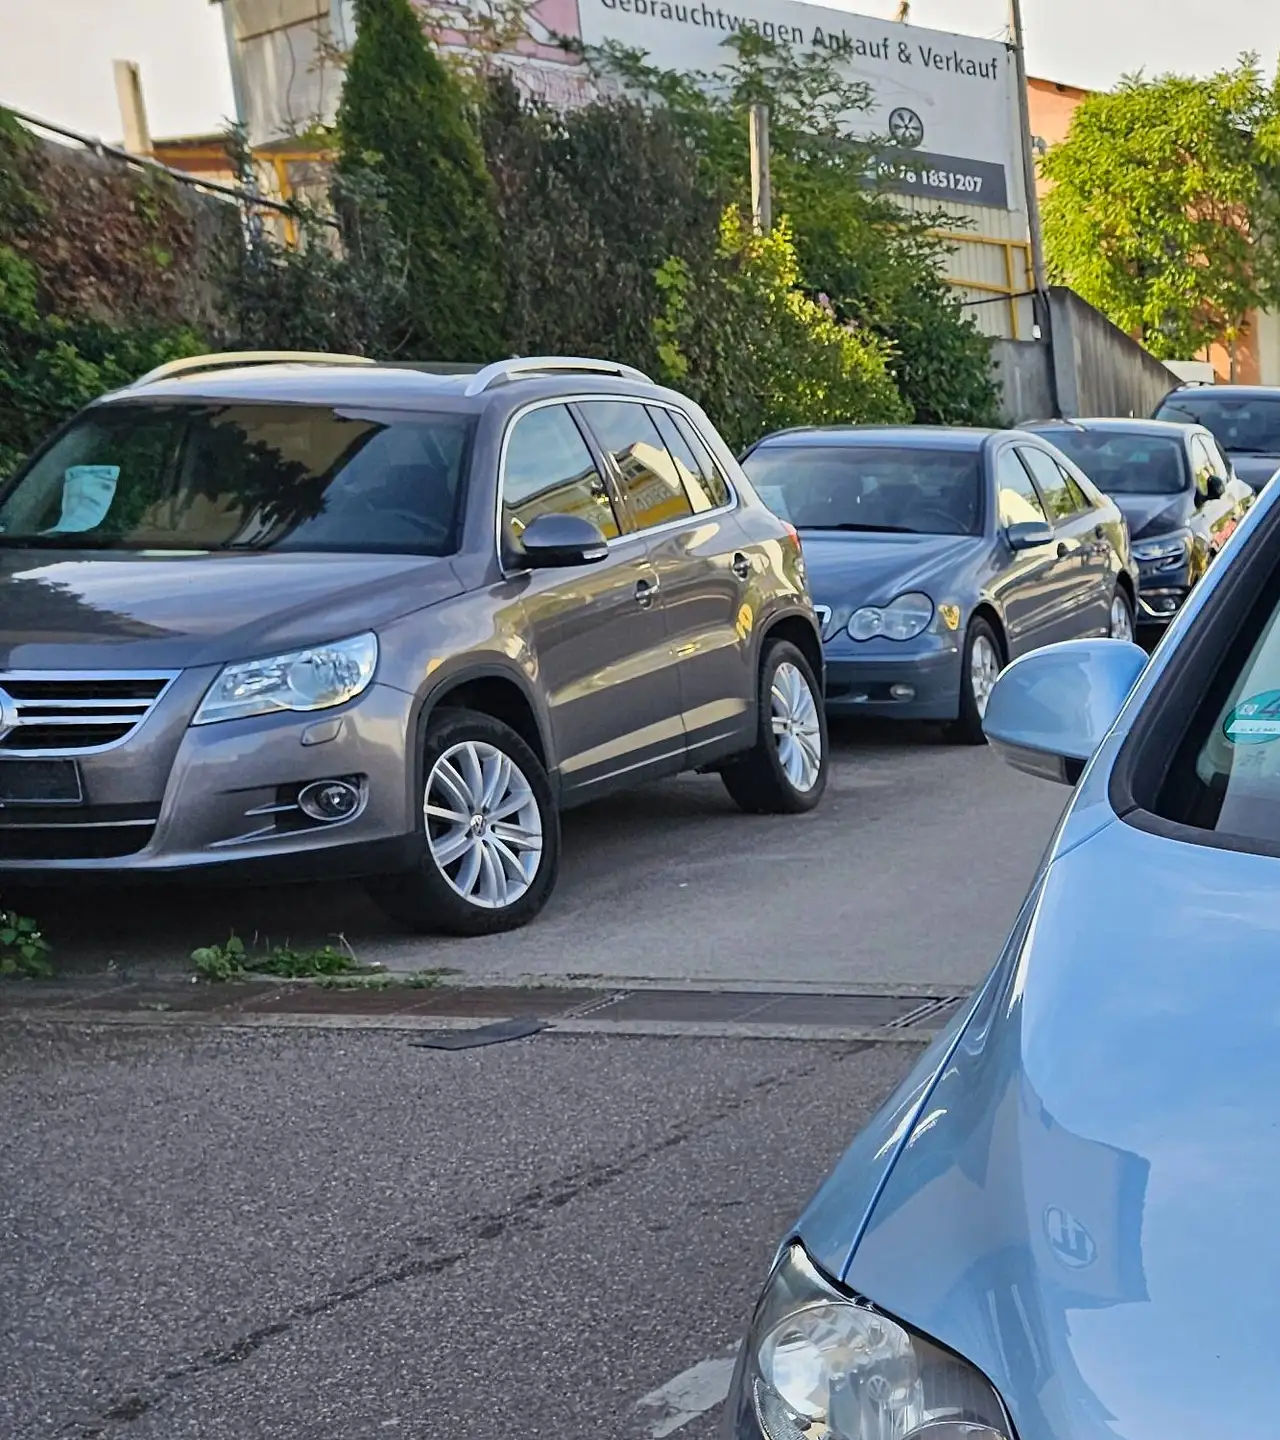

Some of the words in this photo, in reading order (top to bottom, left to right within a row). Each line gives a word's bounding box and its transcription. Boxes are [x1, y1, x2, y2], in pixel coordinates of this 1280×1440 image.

[811, 26, 889, 60] Ankauf
[898, 41, 913, 65] &
[918, 45, 998, 80] Verkauf
[921, 169, 983, 193] 1851207
